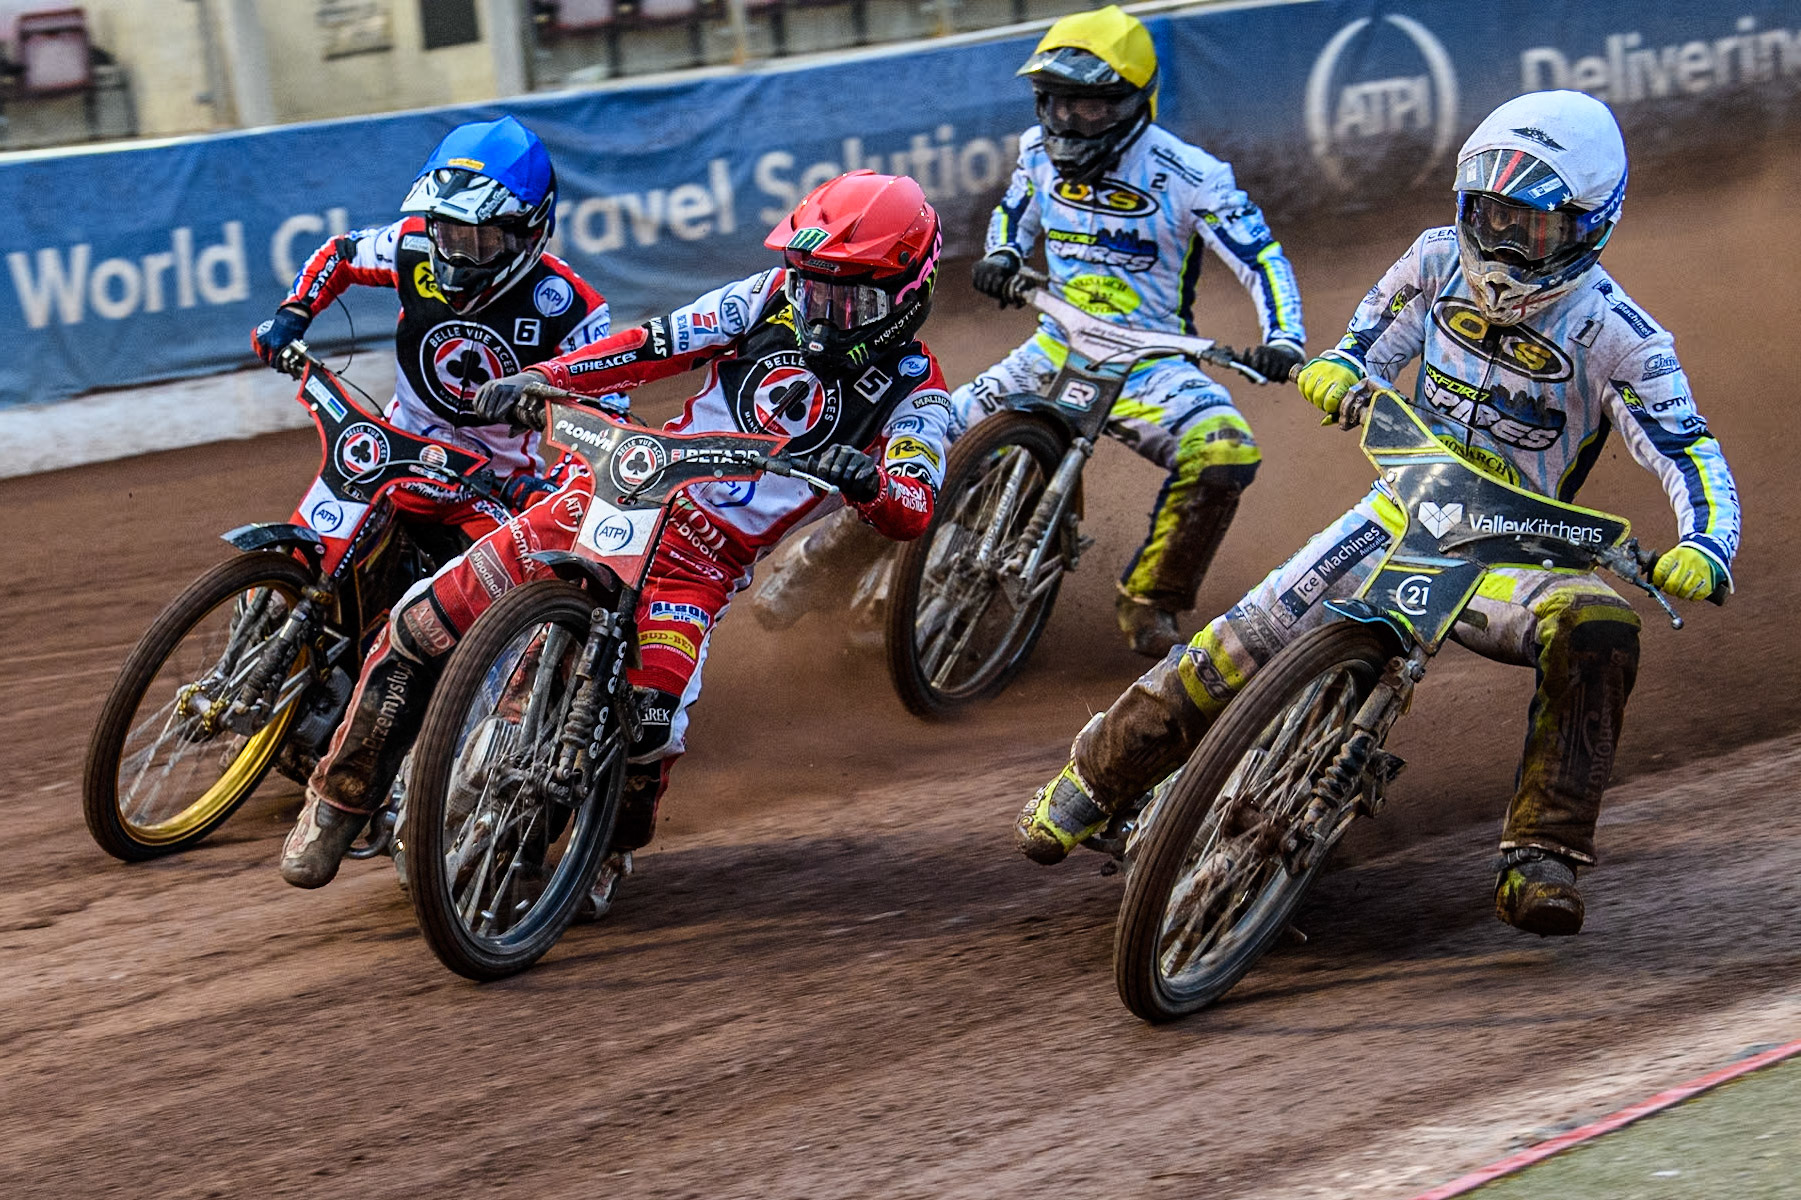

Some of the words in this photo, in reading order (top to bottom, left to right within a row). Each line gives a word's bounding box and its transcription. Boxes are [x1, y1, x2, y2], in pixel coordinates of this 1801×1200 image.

[1151, 173, 1167, 190] 2
[8, 222, 250, 329] World
[554, 158, 733, 257] ravel
[540, 287, 564, 306] ATPI
[723, 301, 744, 332] ATPI
[874, 302, 922, 345] MONSTER
[1575, 319, 1595, 341] 1
[516, 321, 537, 343] 6
[429, 326, 461, 348] BELLE
[466, 328, 492, 345] VUE
[493, 345, 515, 374] ACES
[764, 354, 807, 370] BELLE
[824, 388, 838, 422] ACES
[857, 369, 890, 396] 5
[345, 427, 365, 439] BELLE
[366, 427, 380, 438] VUE
[378, 440, 387, 459] ACES
[617, 440, 637, 457] BELLE
[639, 439, 652, 448] VUE
[652, 444, 664, 464] ACES
[316, 509, 338, 525] ATPI
[1468, 512, 1604, 545] ValleyKitchens
[599, 526, 628, 541] ATPI
[1359, 534, 1387, 557] Australia
[472, 551, 502, 599] Alpodach
[1298, 578, 1320, 598] Ice
[1318, 526, 1380, 577] Machines
[1407, 585, 1430, 606] 21
[413, 607, 451, 650] AMD
[641, 707, 671, 722] REK
